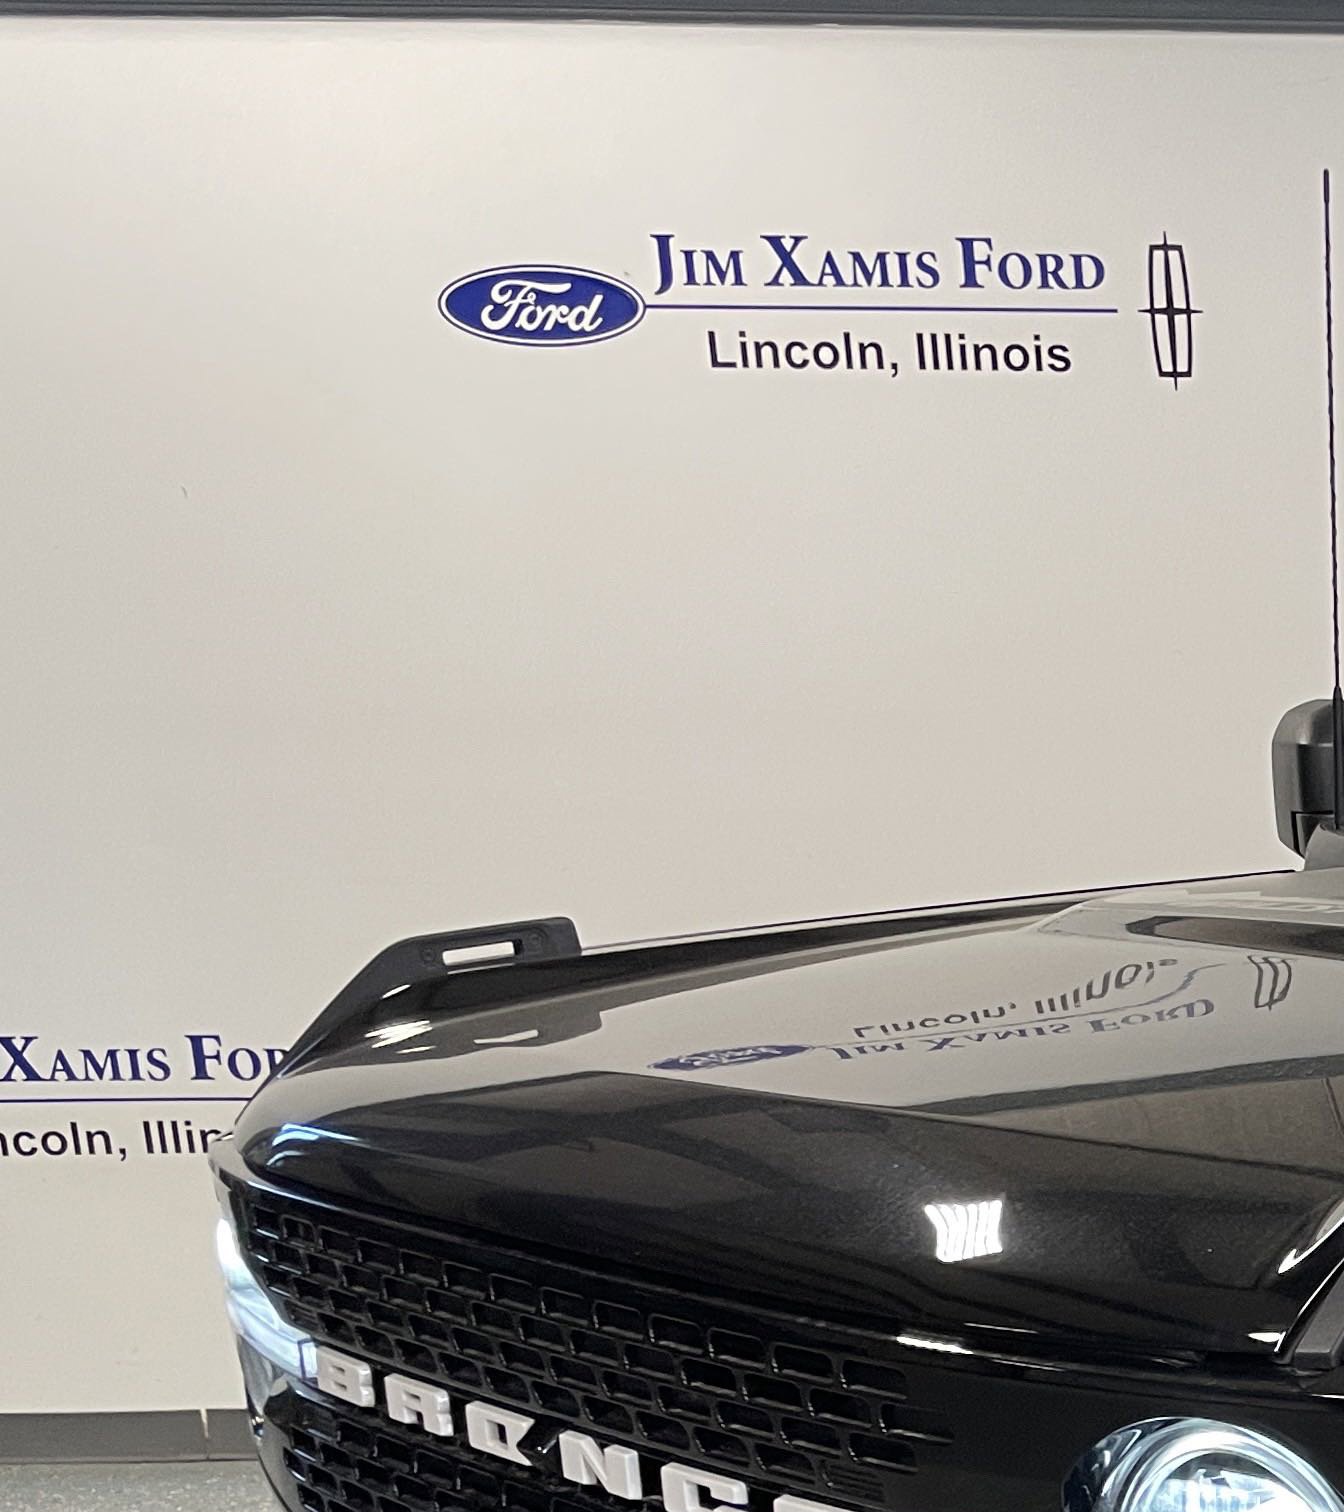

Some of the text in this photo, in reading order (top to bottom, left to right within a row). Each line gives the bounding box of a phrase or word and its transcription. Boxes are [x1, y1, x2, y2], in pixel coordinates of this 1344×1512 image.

[650, 233, 1106, 294] JIM XAMIS FORD
[481, 279, 604, 334] Ford
[708, 331, 1073, 377] Lincoln, Illinois
